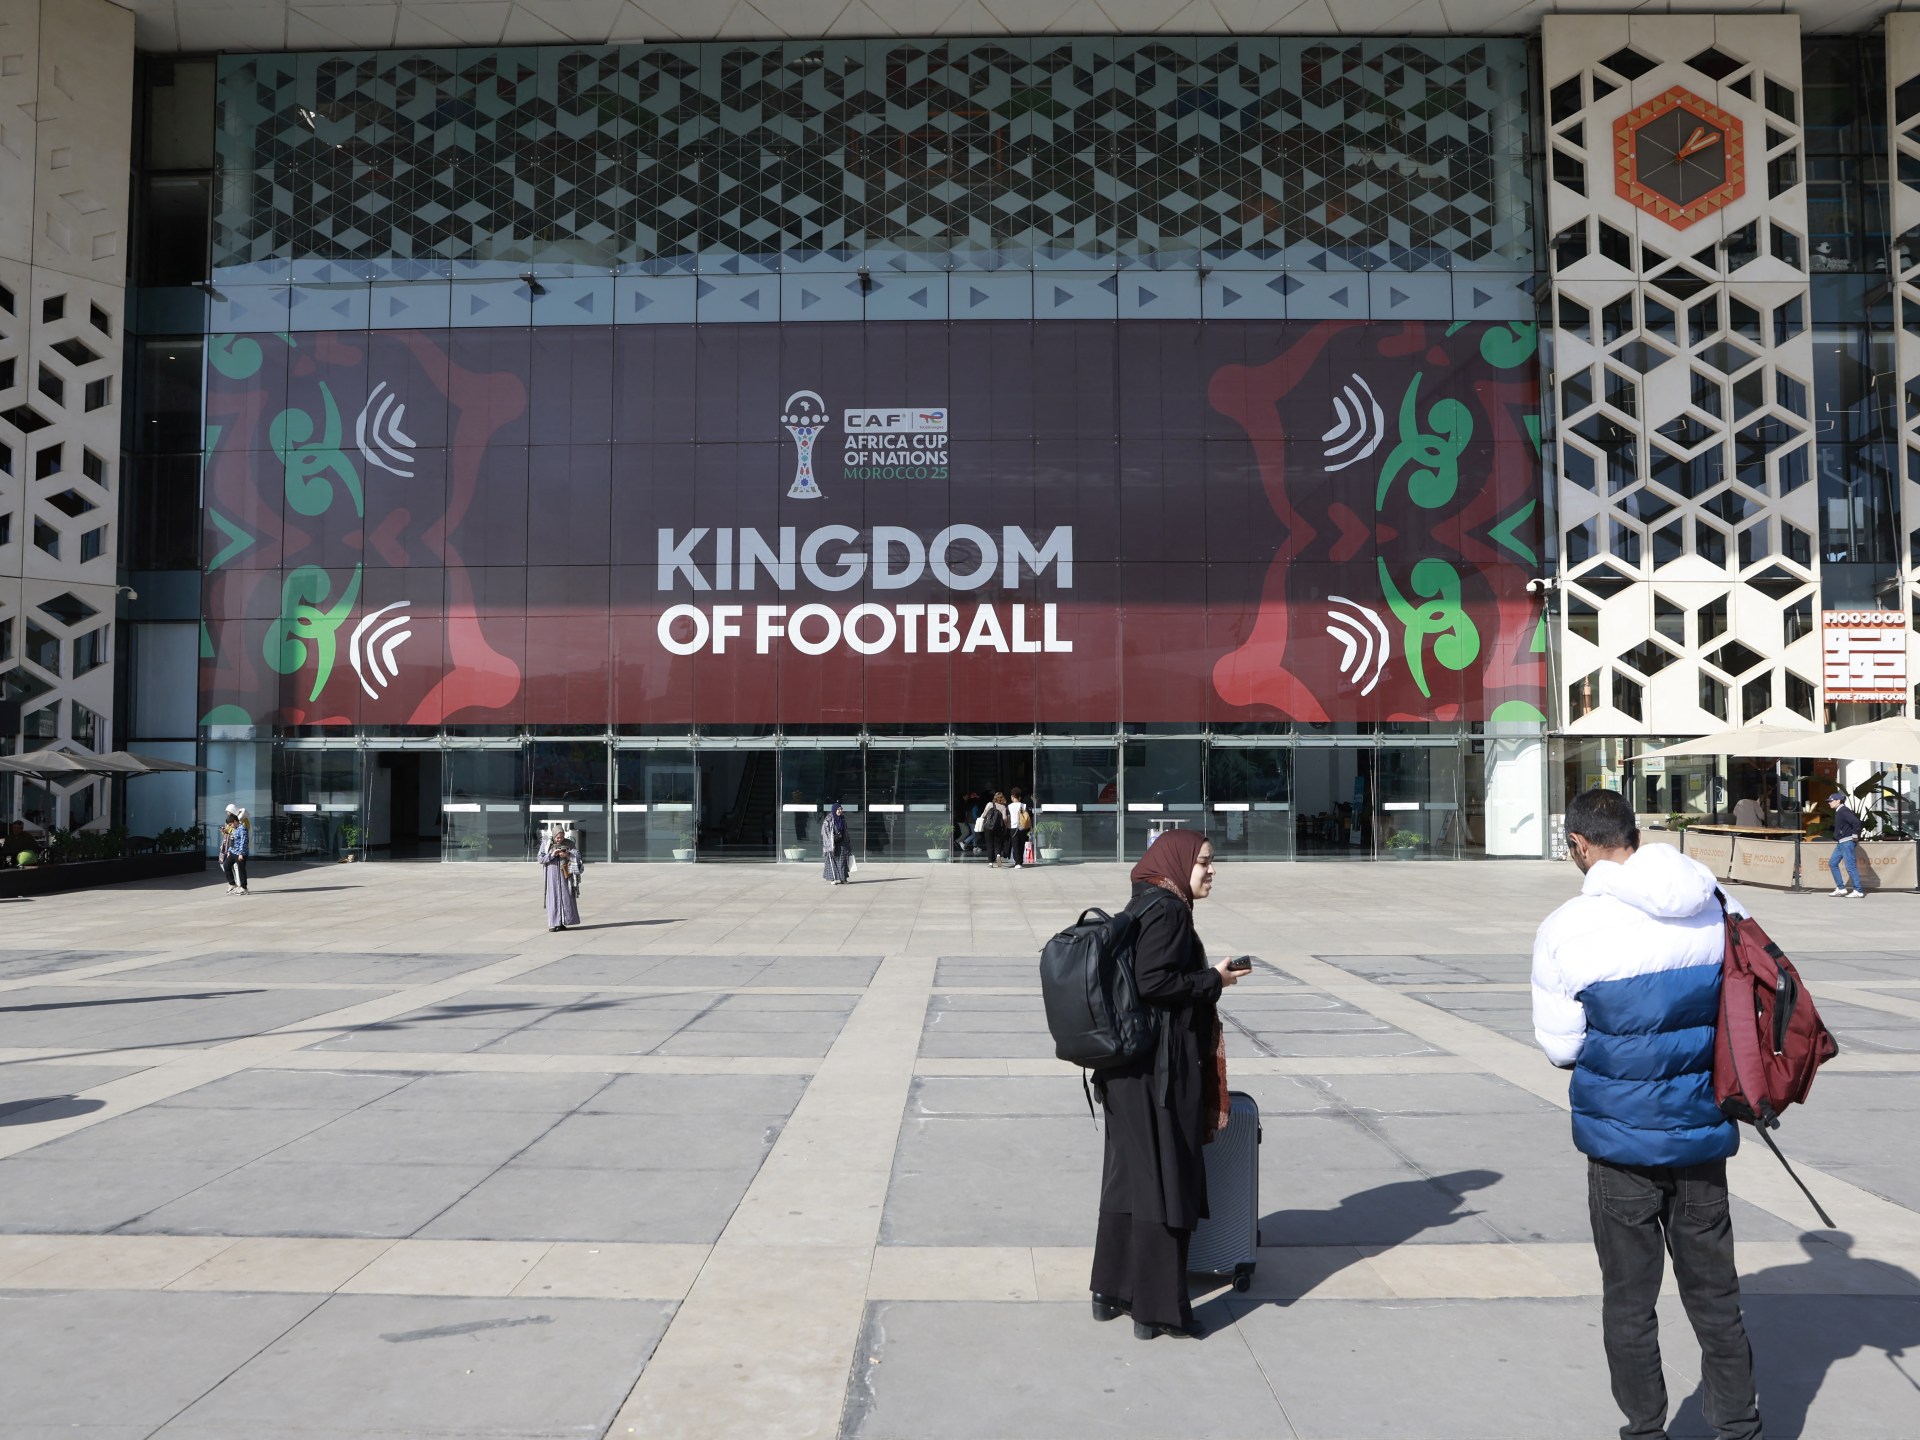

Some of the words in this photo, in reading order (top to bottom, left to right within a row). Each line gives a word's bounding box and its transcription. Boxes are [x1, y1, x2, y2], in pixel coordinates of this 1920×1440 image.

[847, 414, 901, 427] CAF
[844, 434, 908, 449] AFRICA
[912, 434, 948, 449] CUP
[844, 451, 868, 466] OF
[872, 450, 948, 465] NATIONS
[844, 466, 927, 479] MOROCCO
[930, 467, 948, 479] 25
[657, 523, 1073, 592] KINGDOM
[1824, 612, 1905, 624] MOOJOOD
[657, 603, 743, 655] OF
[756, 602, 1073, 655] FOOTBALL
[1879, 692, 1906, 701] FOOD
[1753, 854, 1785, 864] MOOJOOD
